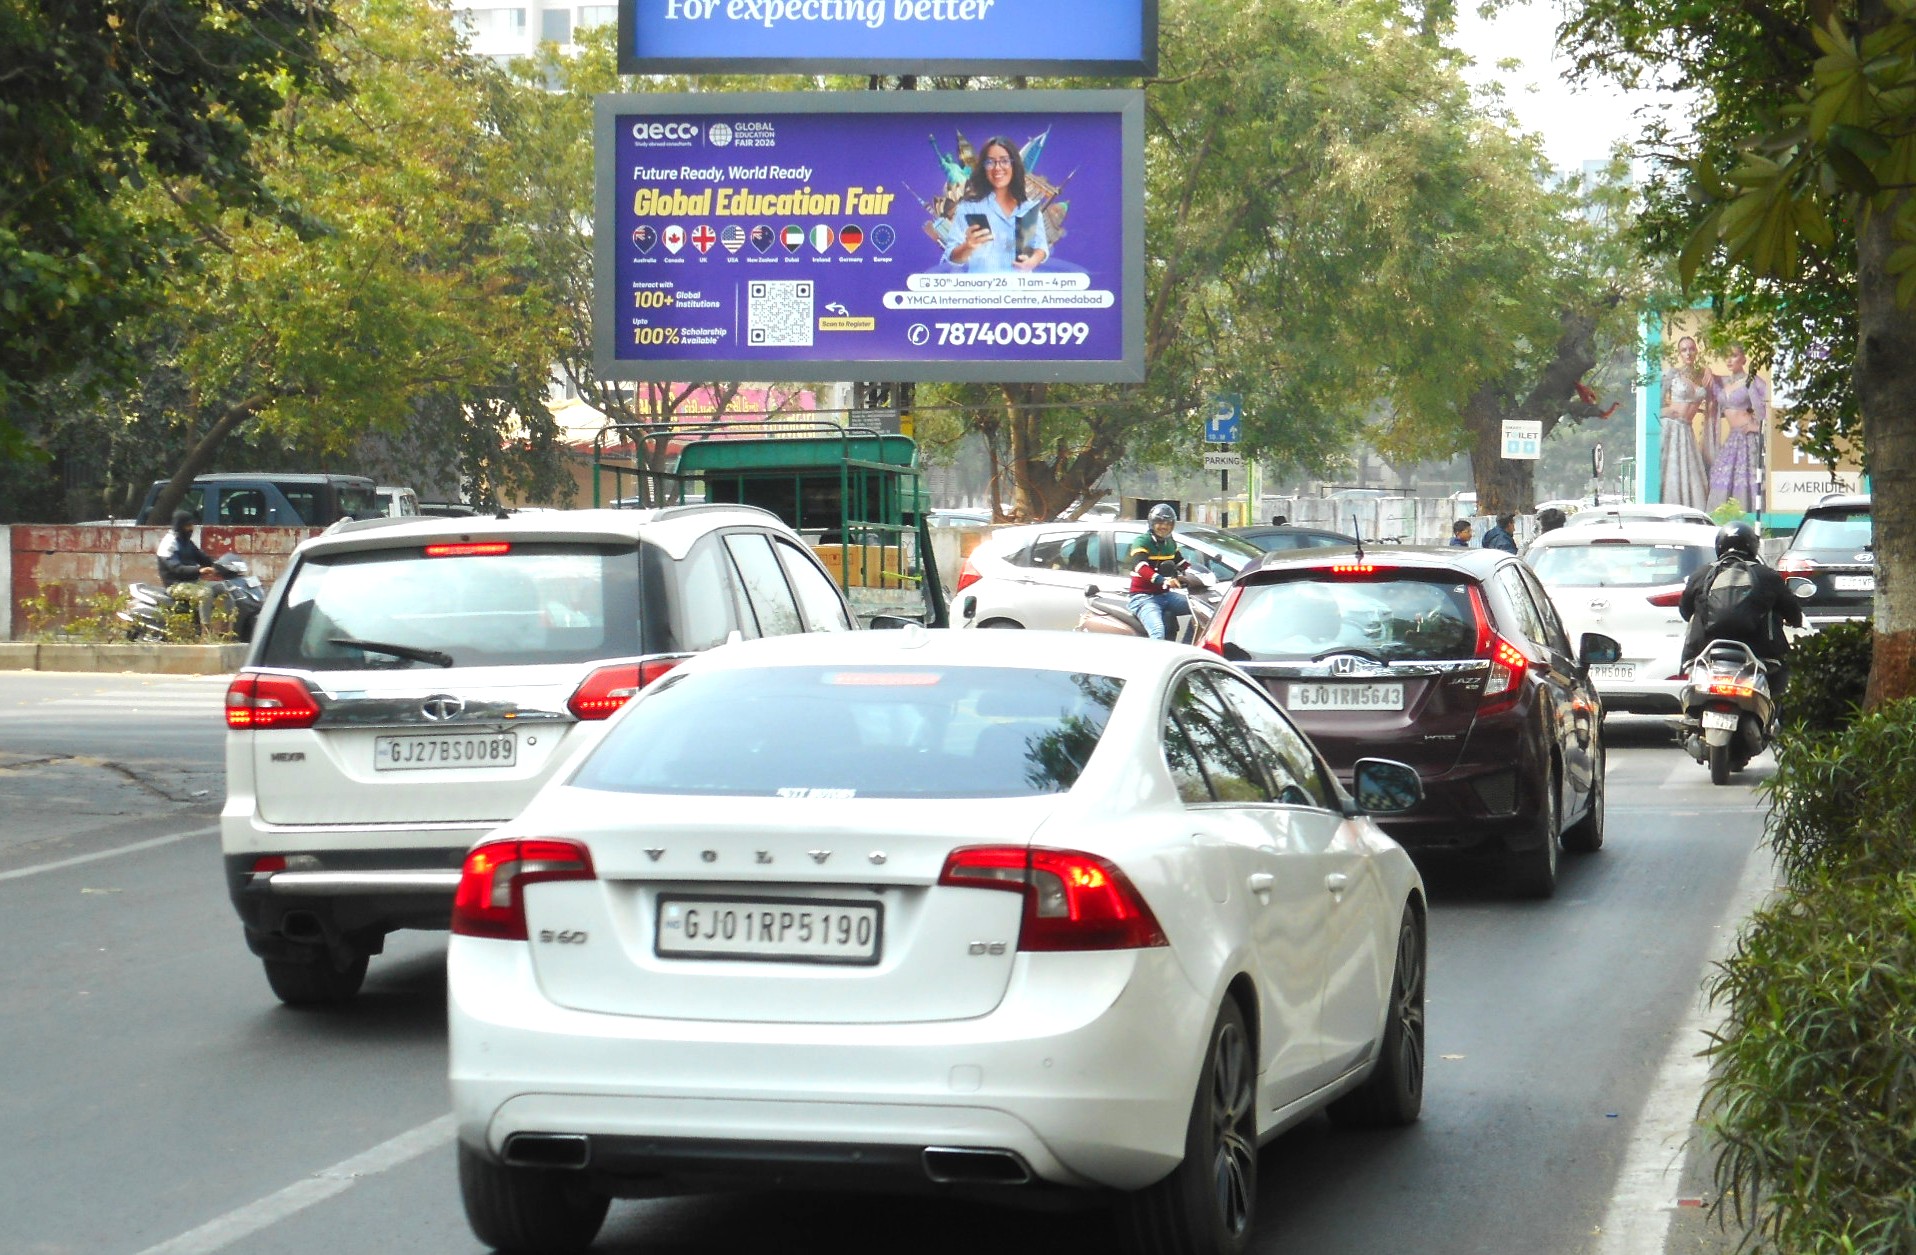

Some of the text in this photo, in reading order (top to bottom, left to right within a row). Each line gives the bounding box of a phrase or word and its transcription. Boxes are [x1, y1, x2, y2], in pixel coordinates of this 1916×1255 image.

[665, 0, 995, 28] For expecting better
[633, 123, 692, 140] aecc
[735, 122, 775, 131] GLOBAL
[735, 139, 775, 147] FAIR 2026
[634, 165, 812, 183] Future Ready, World Ready
[633, 186, 895, 216] Global Education Fair
[1060, 280, 1076, 289] pm
[634, 291, 674, 308] 100+
[676, 291, 701, 299] Global
[907, 294, 1102, 306] YMCA International Centre, Ahmedabad
[676, 300, 720, 308] Institutions
[634, 327, 680, 345] 100%
[681, 328, 727, 337] Scholarship
[935, 322, 1089, 345] 7874003199
[1205, 457, 1240, 465] PARKING
[1793, 481, 1856, 493] MERIDIEN
[391, 738, 513, 763] GJ27BS0089
[684, 908, 873, 947] GJ01RP5190
